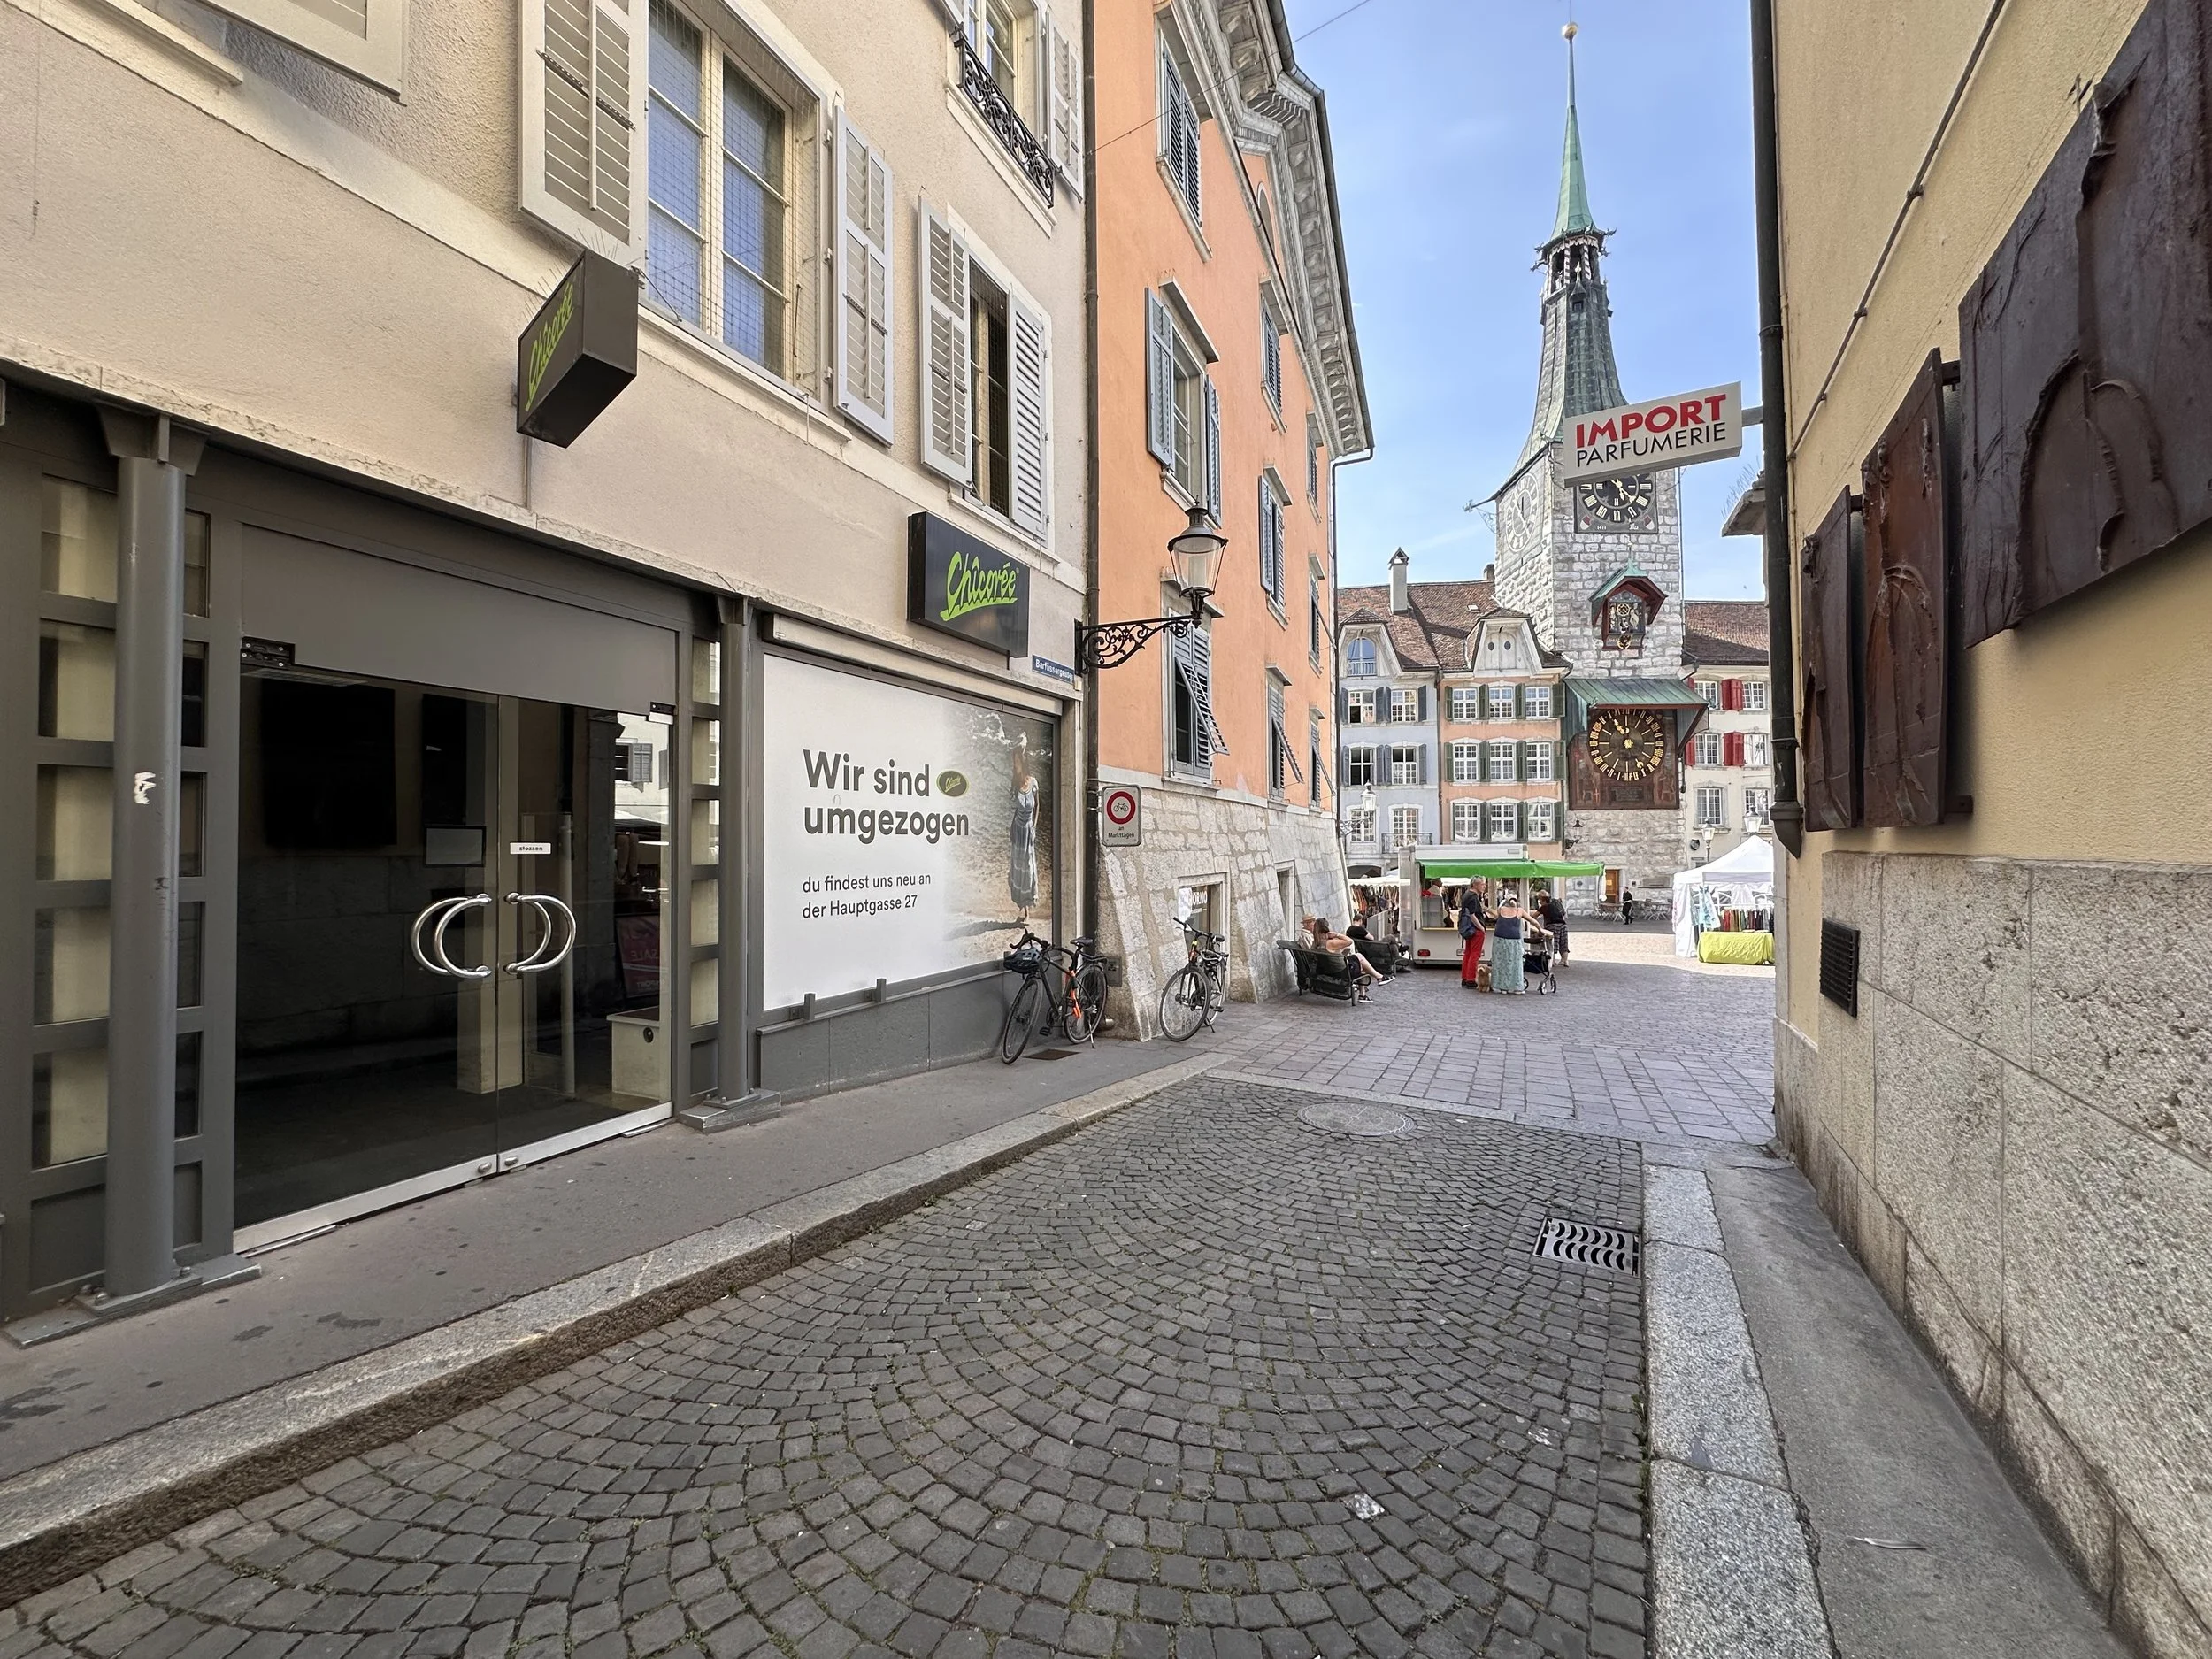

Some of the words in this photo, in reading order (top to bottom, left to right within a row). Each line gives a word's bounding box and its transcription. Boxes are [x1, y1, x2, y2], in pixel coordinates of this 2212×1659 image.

[1576, 394, 1727, 449] IMPORT
[1577, 422, 1726, 467] PARFUMERIE
[803, 749, 864, 792] Wir
[873, 758, 930, 797] sind
[804, 807, 969, 844] umgezogen
[803, 876, 820, 893] du
[825, 874, 869, 891] findest
[872, 876, 893, 888] uns
[896, 875, 916, 887] neu
[918, 874, 931, 885] an
[803, 902, 826, 918] der
[830, 898, 902, 917] Hauptgasse
[904, 895, 918, 908] 27
